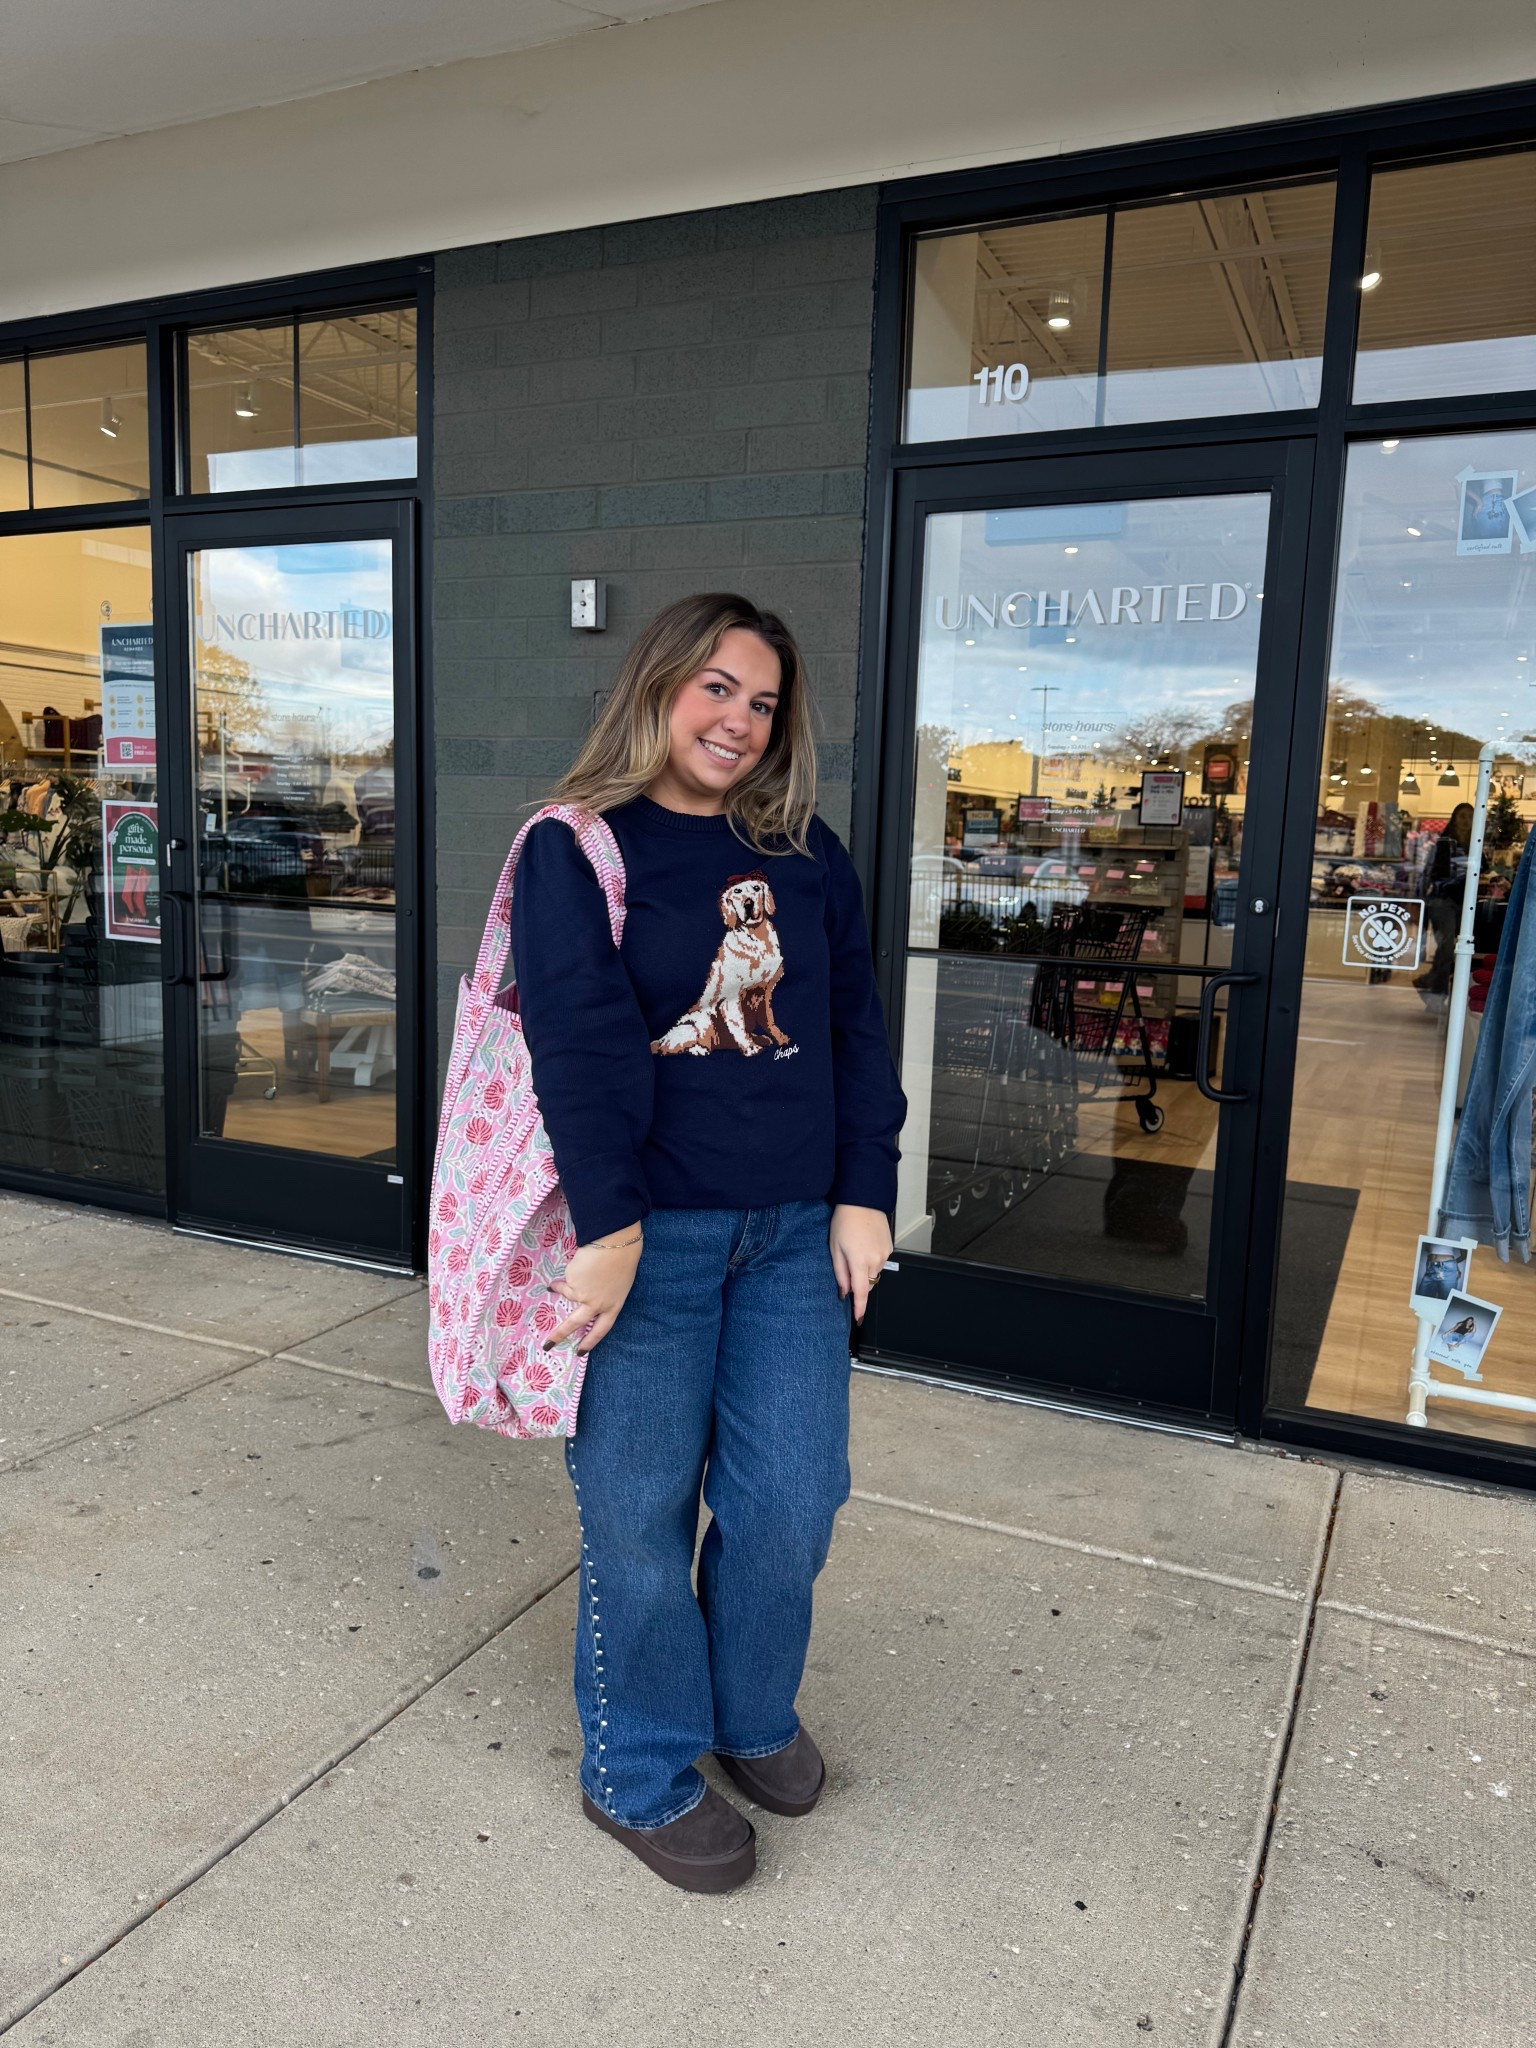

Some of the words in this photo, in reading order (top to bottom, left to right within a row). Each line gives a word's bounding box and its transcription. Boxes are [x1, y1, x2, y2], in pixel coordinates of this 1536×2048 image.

[973, 363, 1029, 404] 110
[111, 637, 154, 647] UNCHARTED
[1041, 721, 1074, 733] store
[1074, 720, 1114, 733] hours
[127, 822, 145, 836] gifts
[124, 834, 148, 845] made
[119, 843, 154, 855] personal
[1358, 904, 1378, 919] NO
[1380, 903, 1411, 921] PETS
[773, 1043, 800, 1061] Chaps
